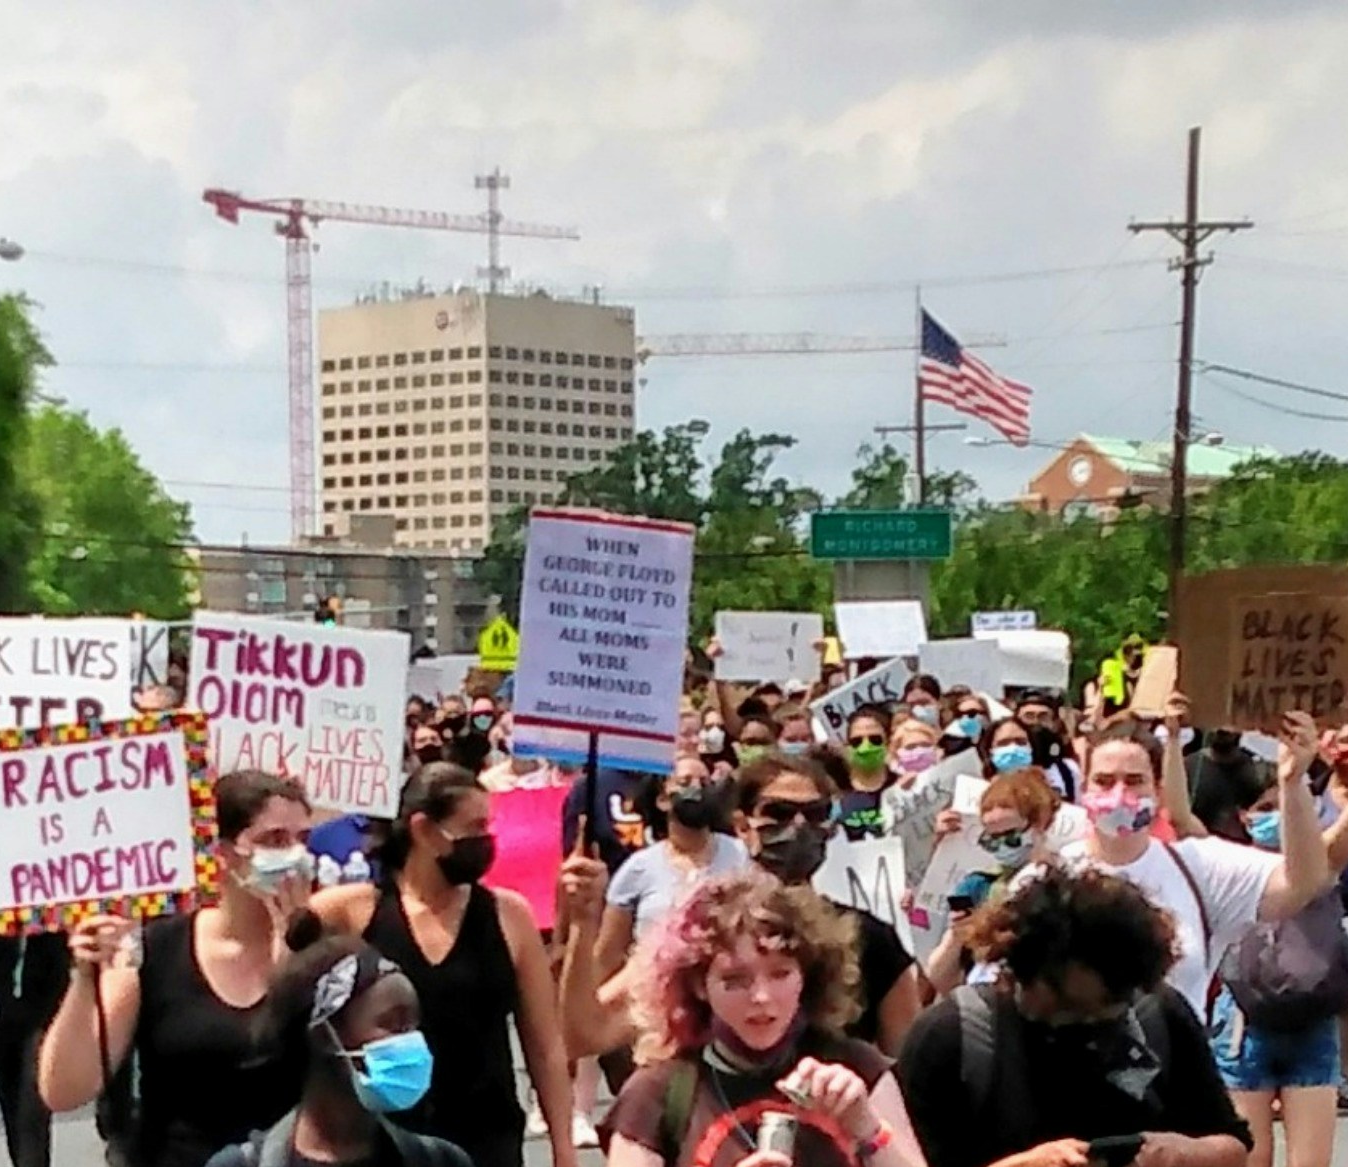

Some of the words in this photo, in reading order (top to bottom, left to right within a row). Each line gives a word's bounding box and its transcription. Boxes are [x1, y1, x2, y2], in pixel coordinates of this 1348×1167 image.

[844, 519, 918, 534] RICHARD
[585, 536, 640, 556] WHEN
[823, 538, 938, 552] MONTGOMERY
[542, 554, 615, 577] GEORGE
[618, 563, 676, 584] FLOYD
[539, 577, 605, 598] CALLED
[609, 587, 647, 605] OUT
[652, 590, 677, 608] TO
[549, 602, 579, 617] HIS
[583, 605, 627, 624] MOM
[1242, 609, 1346, 644] BLACK
[559, 627, 589, 643] ALL
[594, 630, 650, 650] MOMS
[31, 636, 118, 681] LIVES
[195, 628, 366, 688] Tikkun
[578, 652, 629, 672] WERE
[1241, 647, 1336, 679] LIVES
[547, 671, 652, 696] SUMMONED
[822, 671, 899, 729] BLACK
[1230, 679, 1348, 718] MATTER
[196, 674, 305, 729] Olam
[304, 721, 385, 766] LIVES
[1, 740, 176, 808] RACISM
[302, 754, 391, 807] MATTER
[39, 813, 64, 847] IS
[92, 806, 113, 837] A
[9, 838, 178, 903] PANDEMIC
